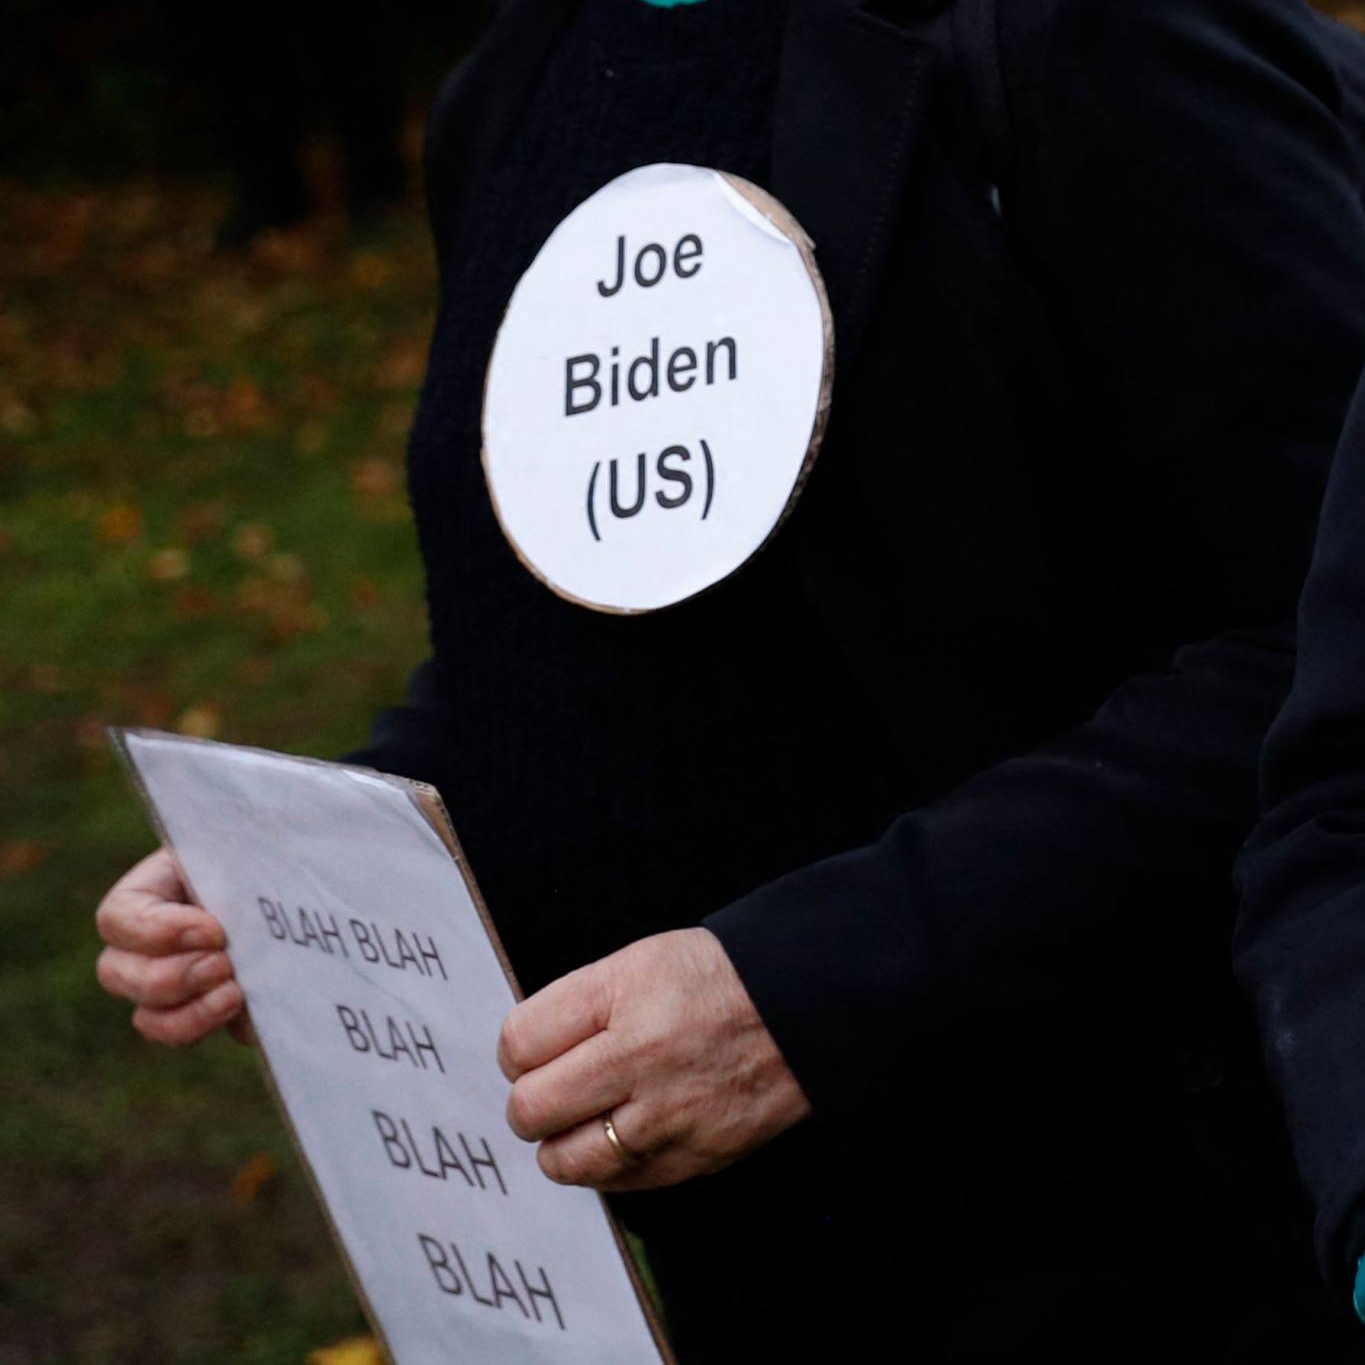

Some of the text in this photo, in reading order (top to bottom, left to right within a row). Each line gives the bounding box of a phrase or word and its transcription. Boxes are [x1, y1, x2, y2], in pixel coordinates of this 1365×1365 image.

[597, 233, 703, 298] Joe
[564, 336, 737, 417] Biden
[586, 439, 715, 542] (US)
[258, 897, 448, 981] BLAH BLAH
[335, 1004, 446, 1075] BLAH
[371, 1110, 508, 1196] BLAH
[417, 1233, 566, 1332] BLAH
